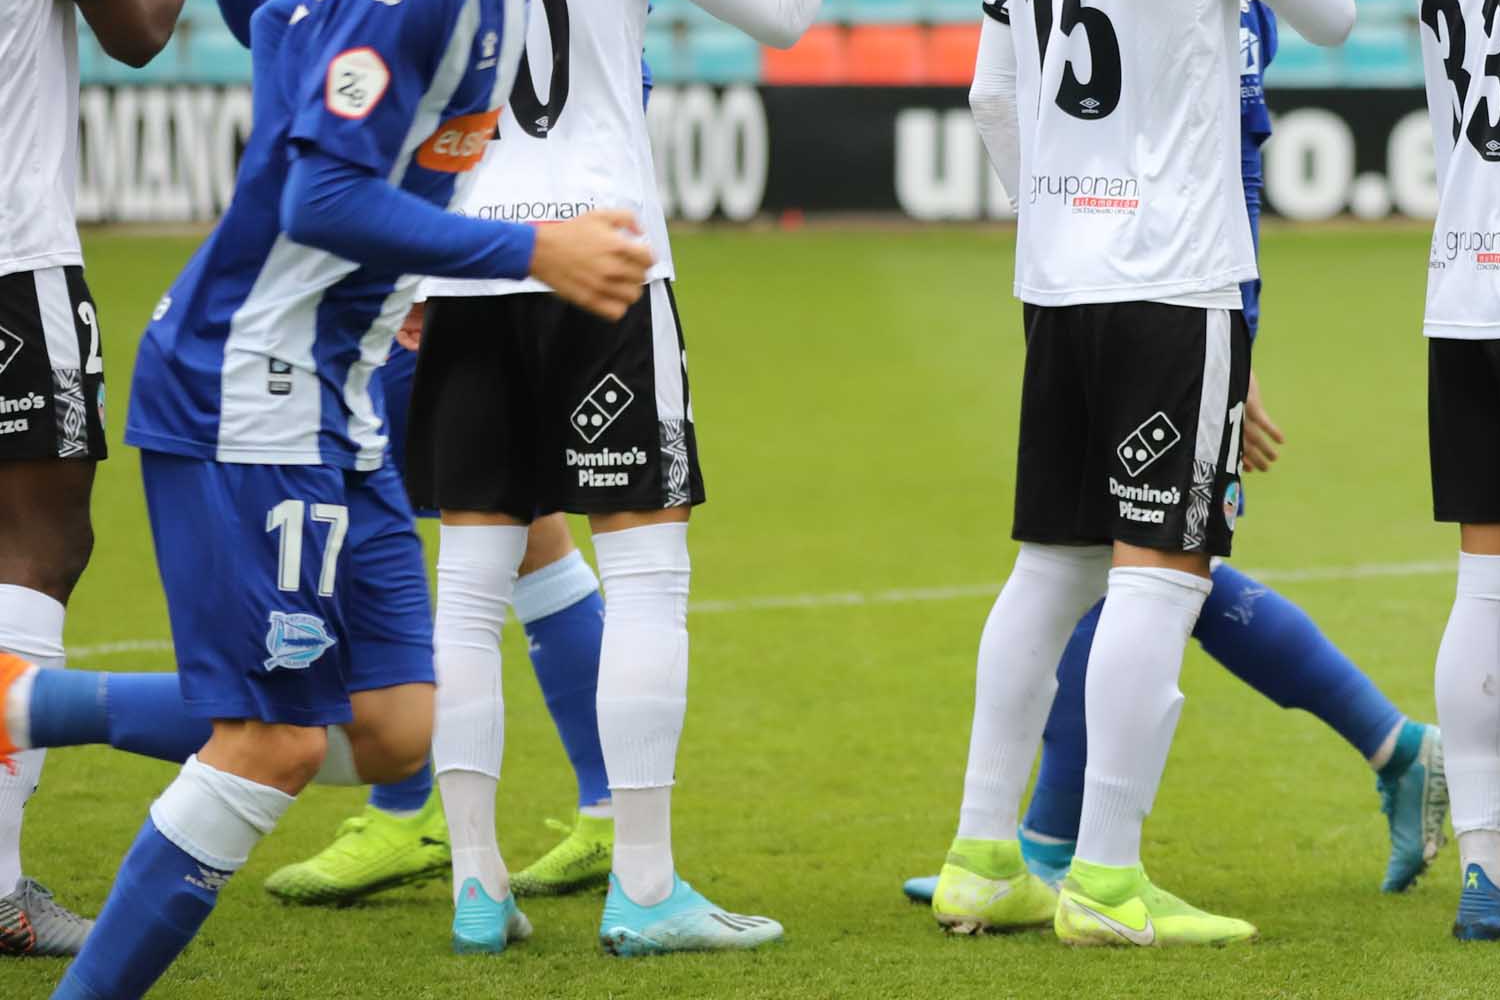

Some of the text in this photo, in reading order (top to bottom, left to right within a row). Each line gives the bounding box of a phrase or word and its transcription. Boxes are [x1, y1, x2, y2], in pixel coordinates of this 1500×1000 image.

[1030, 175, 1140, 205] gruponan
[0, 392, 46, 414] ino's
[0, 418, 29, 434] zza
[566, 447, 647, 467] Domino's
[578, 469, 629, 487] Pizza
[1109, 477, 1181, 505] Domino's
[1119, 501, 1165, 524] Pizza
[265, 499, 350, 597] 17
